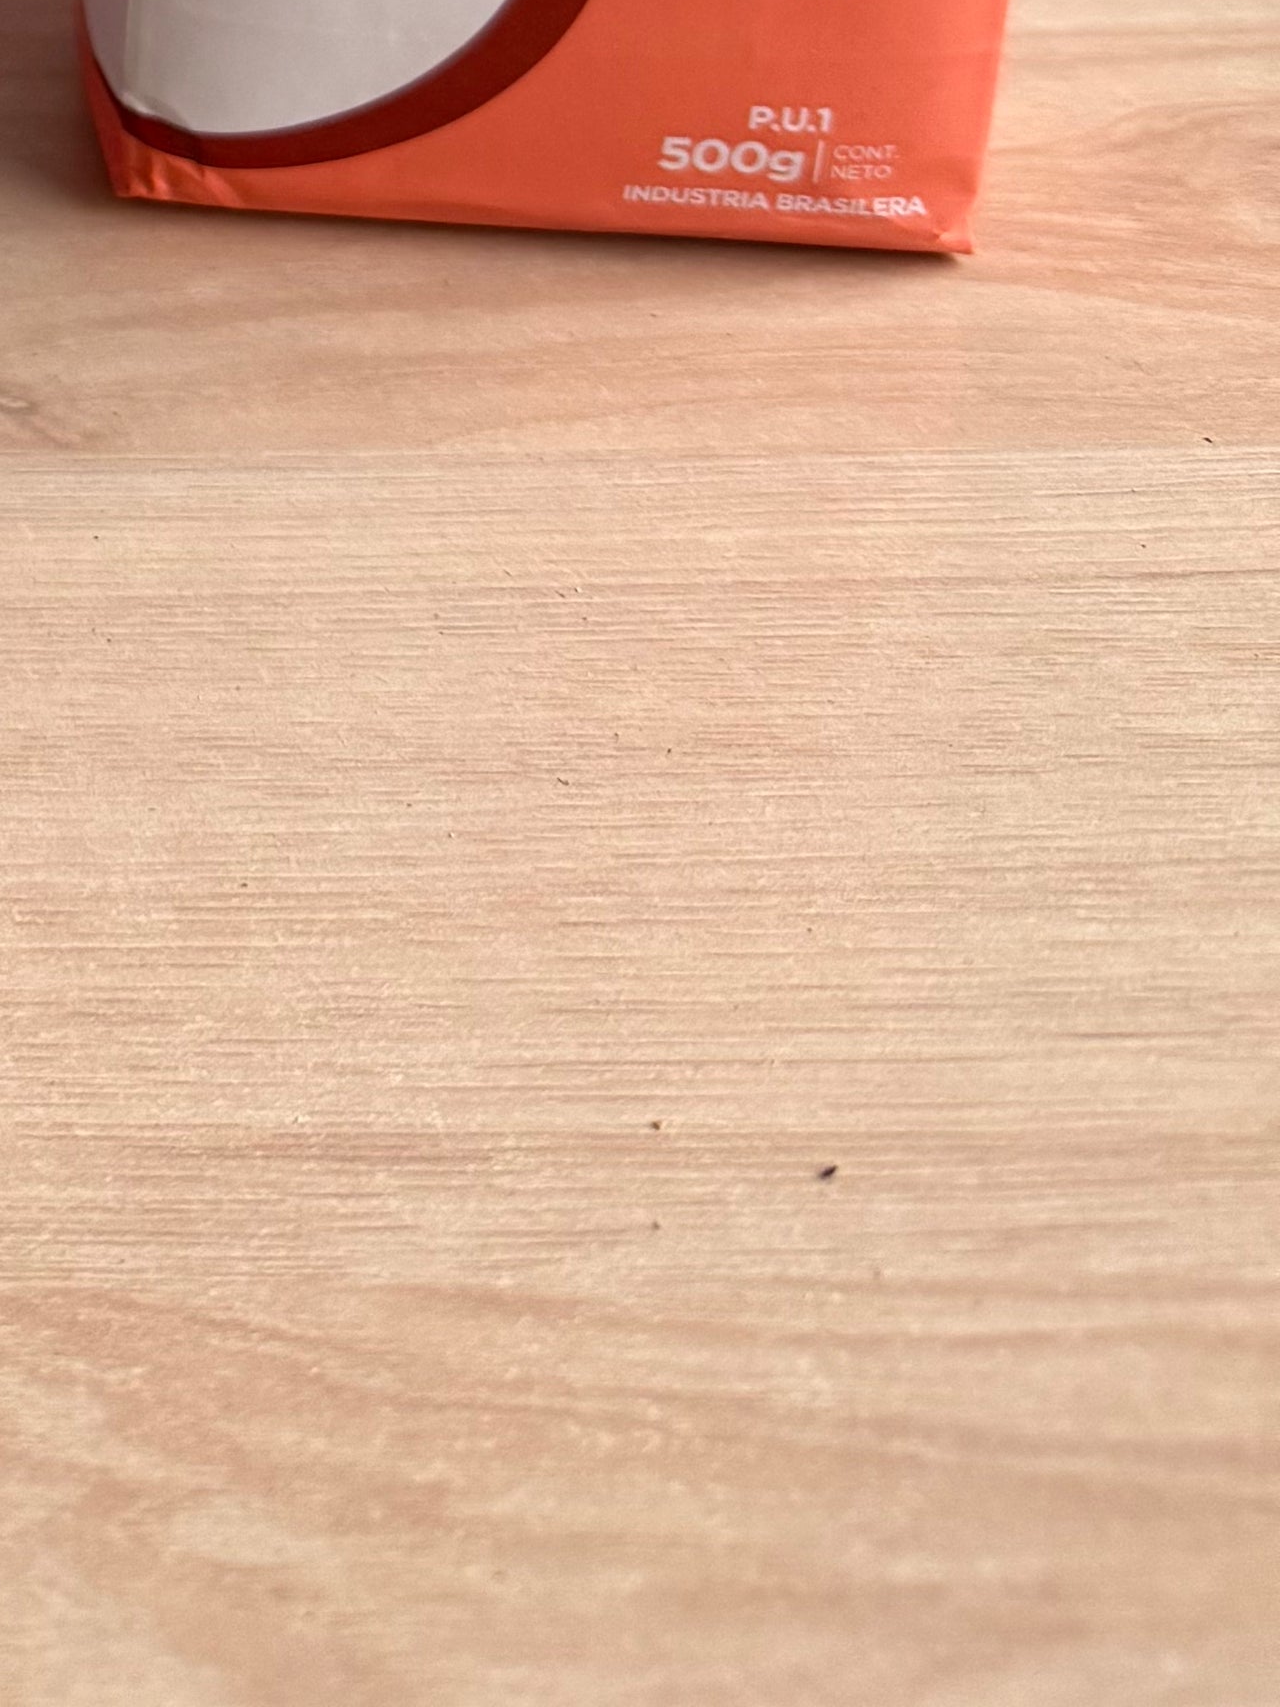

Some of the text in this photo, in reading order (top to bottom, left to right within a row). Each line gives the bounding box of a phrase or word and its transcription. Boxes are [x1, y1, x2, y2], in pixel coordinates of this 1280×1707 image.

[748, 105, 833, 133] P.U.1
[657, 136, 804, 184] 500g
[833, 144, 899, 162] CONT.
[830, 163, 892, 181] NETO
[622, 183, 927, 219] INDUSTRIA BRASILERA
